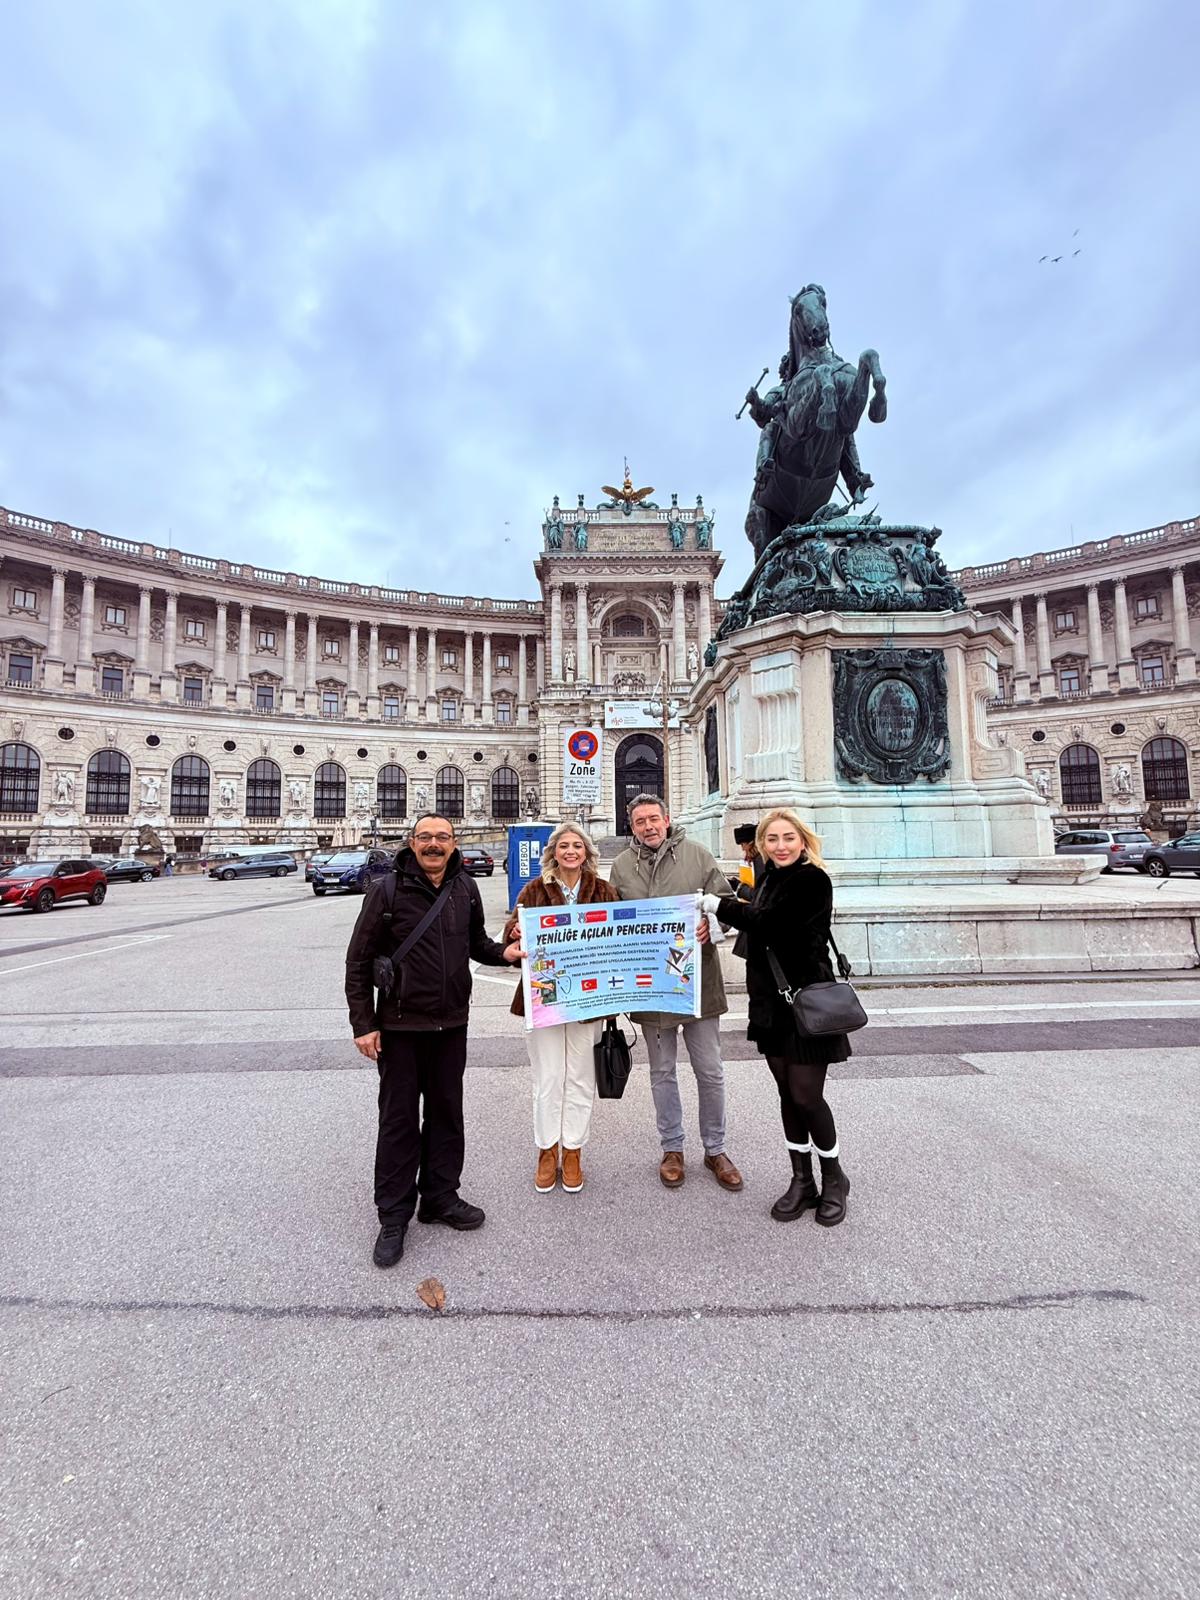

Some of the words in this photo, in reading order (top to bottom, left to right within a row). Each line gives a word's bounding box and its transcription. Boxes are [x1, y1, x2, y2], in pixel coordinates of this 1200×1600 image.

[570, 763, 595, 775] Zone
[536, 930, 578, 946] YENİLİĞE
[580, 926, 613, 942] AÇILAN
[616, 923, 658, 936] PENCERE
[661, 922, 686, 934] STEM
